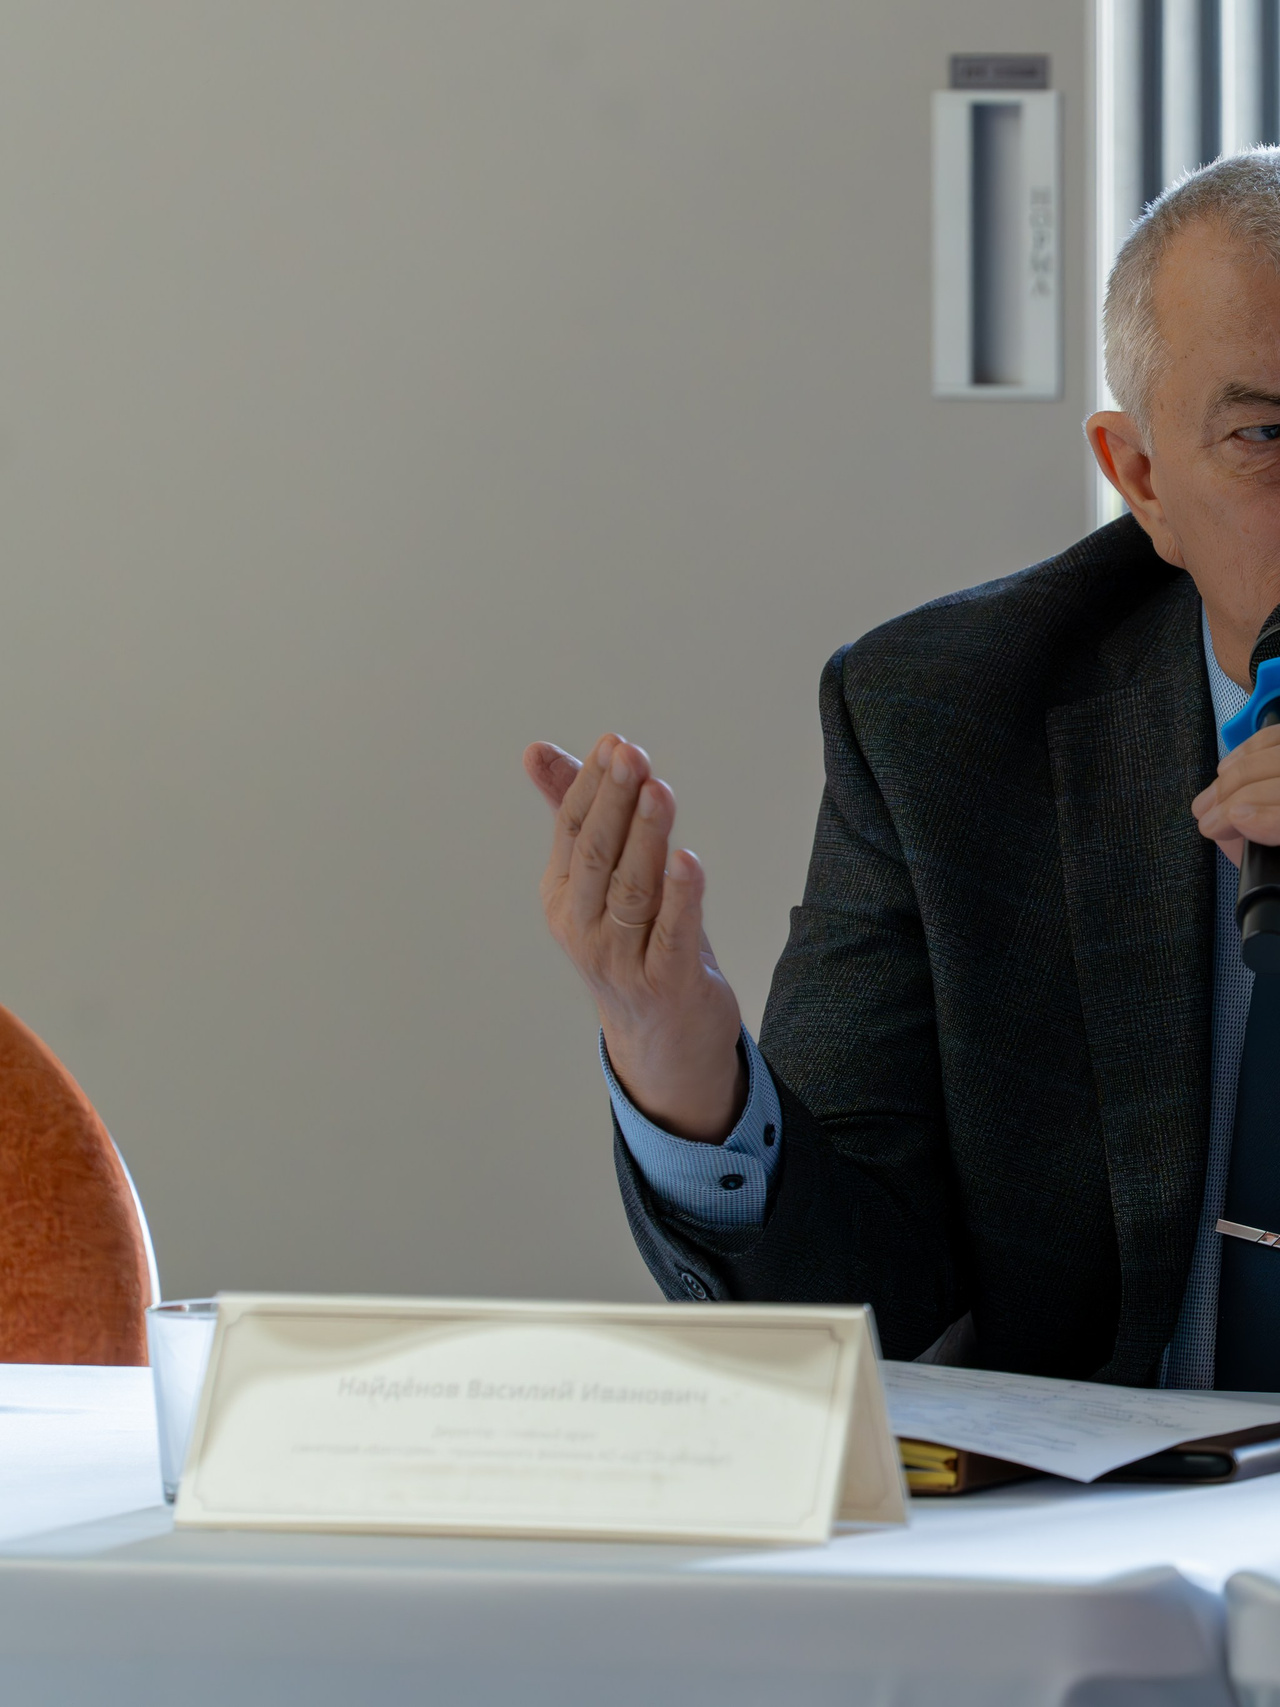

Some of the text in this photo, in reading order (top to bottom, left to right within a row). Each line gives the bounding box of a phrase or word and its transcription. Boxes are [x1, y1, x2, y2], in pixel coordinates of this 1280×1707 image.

[337, 1376, 709, 1406] Найдёнов Василий Иванович
